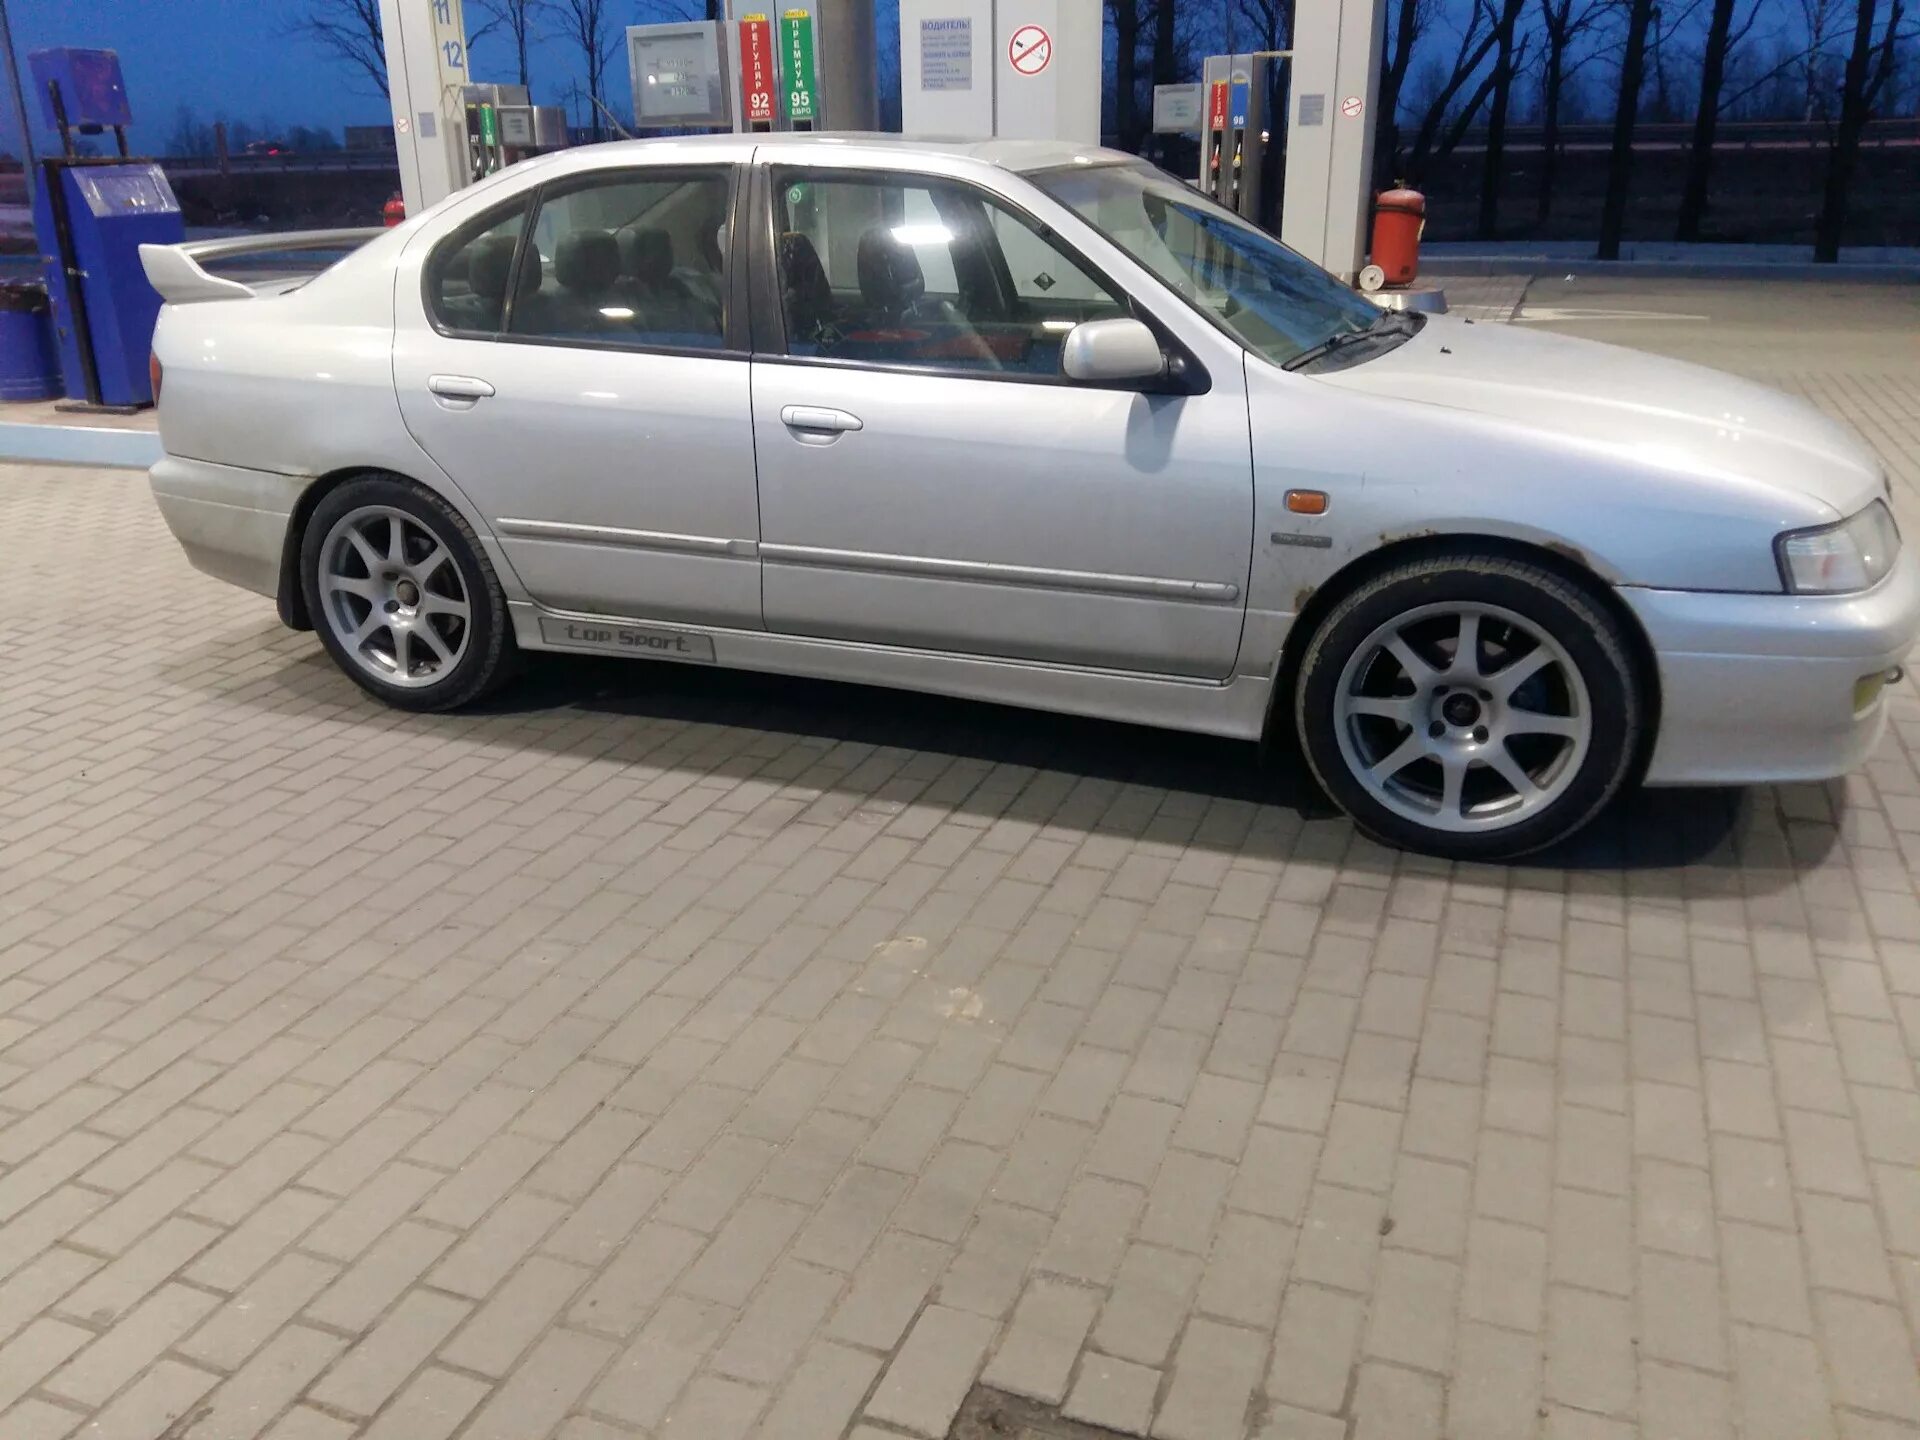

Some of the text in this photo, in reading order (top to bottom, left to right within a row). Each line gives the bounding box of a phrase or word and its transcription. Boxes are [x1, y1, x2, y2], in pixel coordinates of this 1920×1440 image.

[442, 40, 464, 68] 12
[750, 22, 763, 90] РЕГУЛЯР
[792, 19, 804, 89] ПРЕМИУМ
[750, 92, 769, 109] 92
[791, 91, 810, 107] 95
[750, 109, 771, 117] ЕВРО
[791, 107, 811, 116] ЕВРО
[618, 630, 692, 653] Sport
